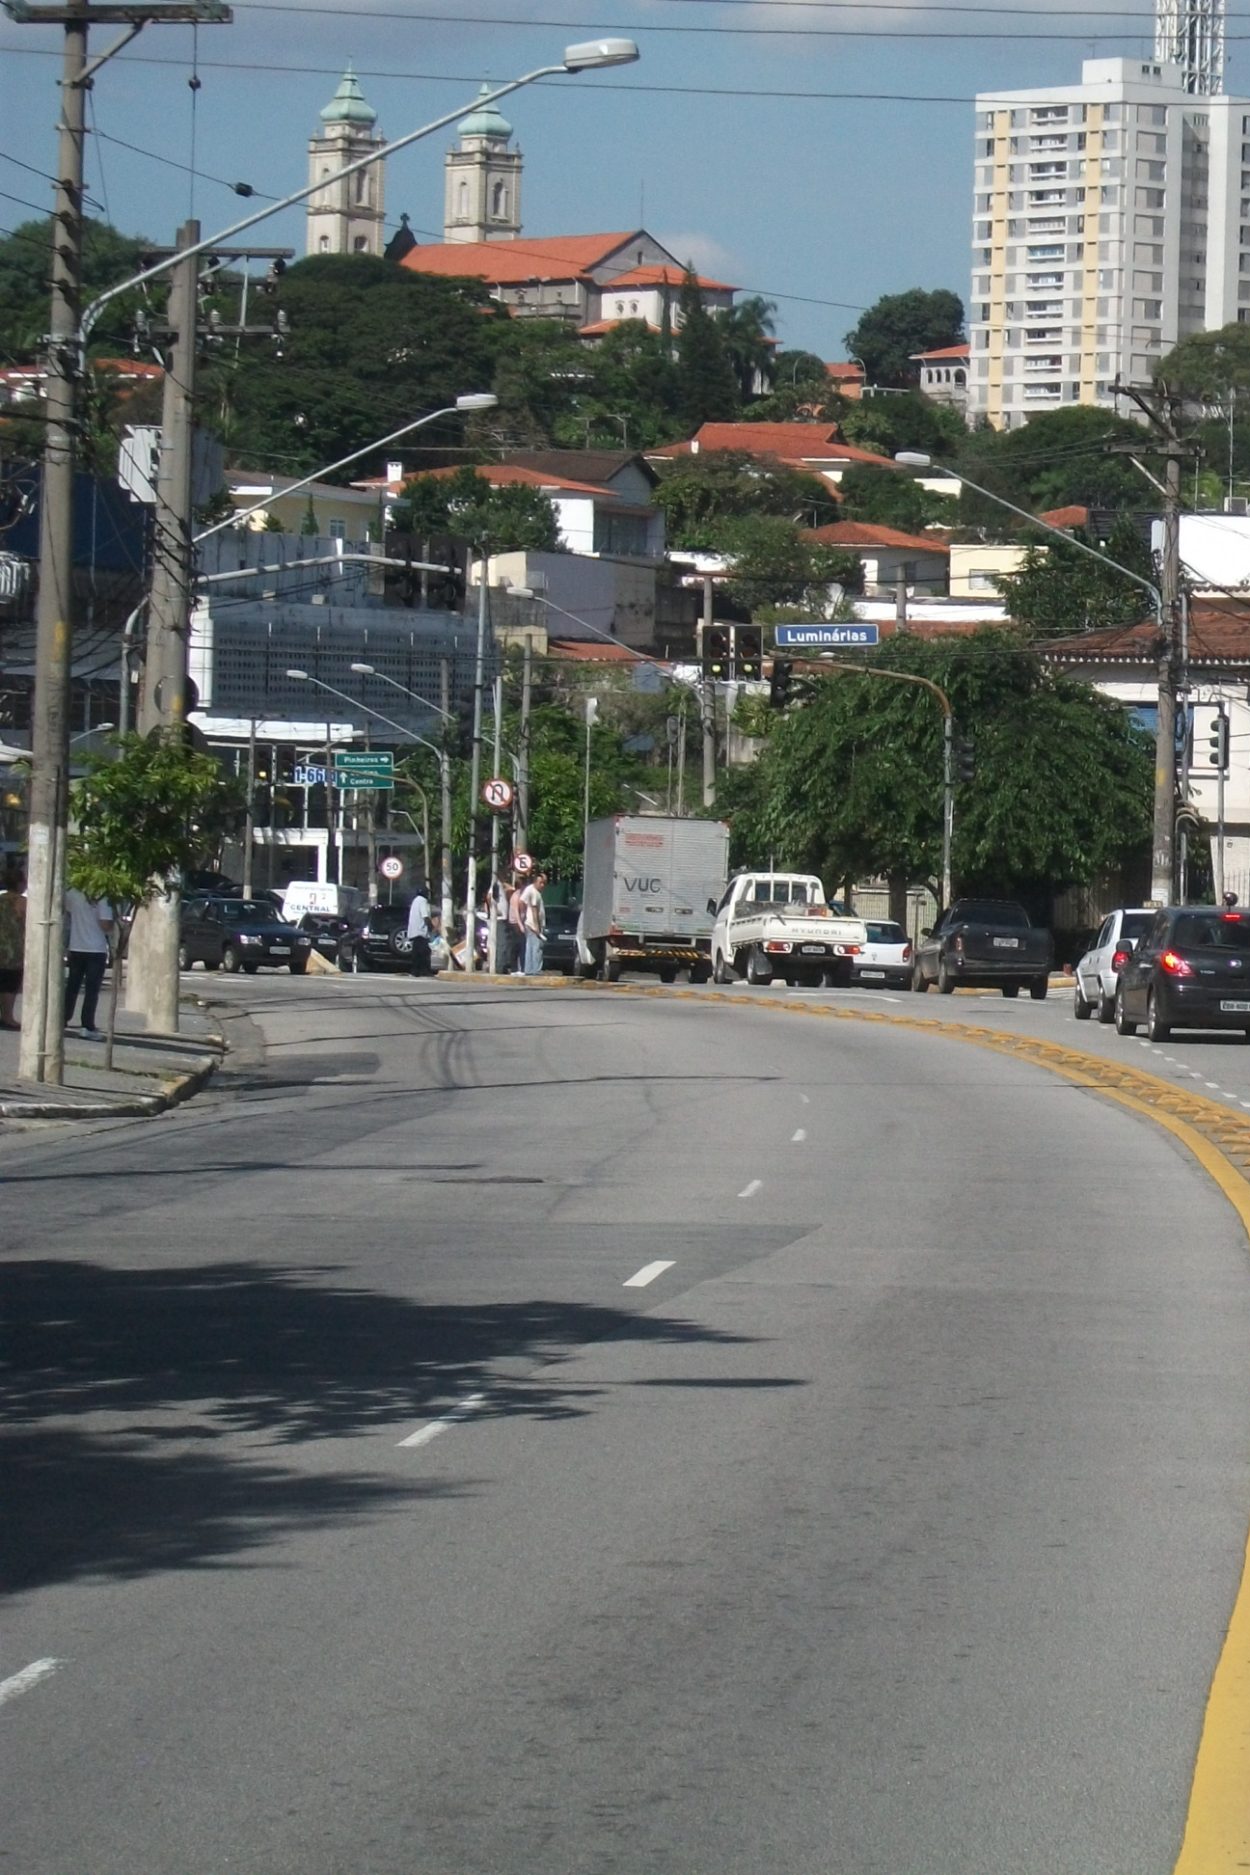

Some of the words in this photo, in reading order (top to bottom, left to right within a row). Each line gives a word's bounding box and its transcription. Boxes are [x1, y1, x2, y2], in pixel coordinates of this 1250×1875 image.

[787, 628, 868, 642] Luminárias
[386, 862, 399, 871] 50
[624, 877, 661, 893] VUC
[290, 904, 331, 912] CENTRAL
